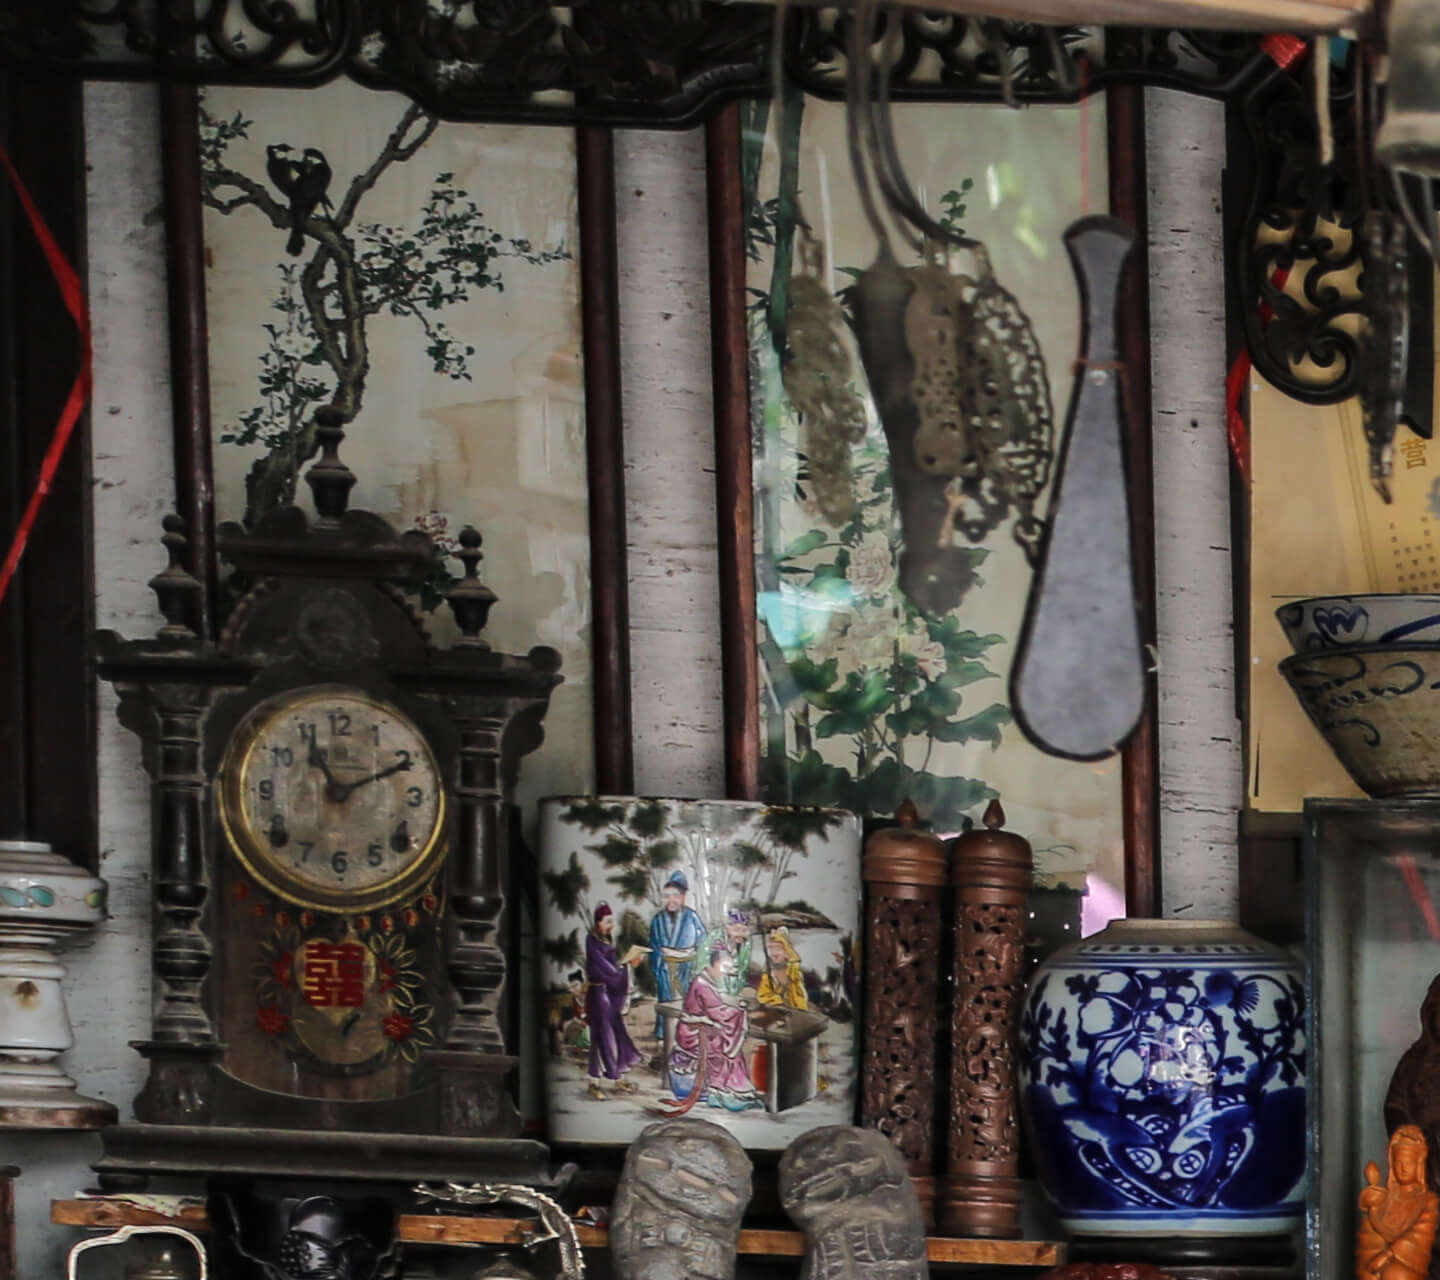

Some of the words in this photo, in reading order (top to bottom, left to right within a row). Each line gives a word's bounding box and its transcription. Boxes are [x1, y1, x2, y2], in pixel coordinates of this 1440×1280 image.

[328, 715, 351, 736] 12
[370, 725, 380, 746] 1
[272, 747, 293, 767] 10
[259, 780, 273, 800] 9
[407, 788, 422, 806] 3
[299, 843, 313, 862] 7
[332, 852, 347, 873] 6
[368, 845, 382, 866] 5
